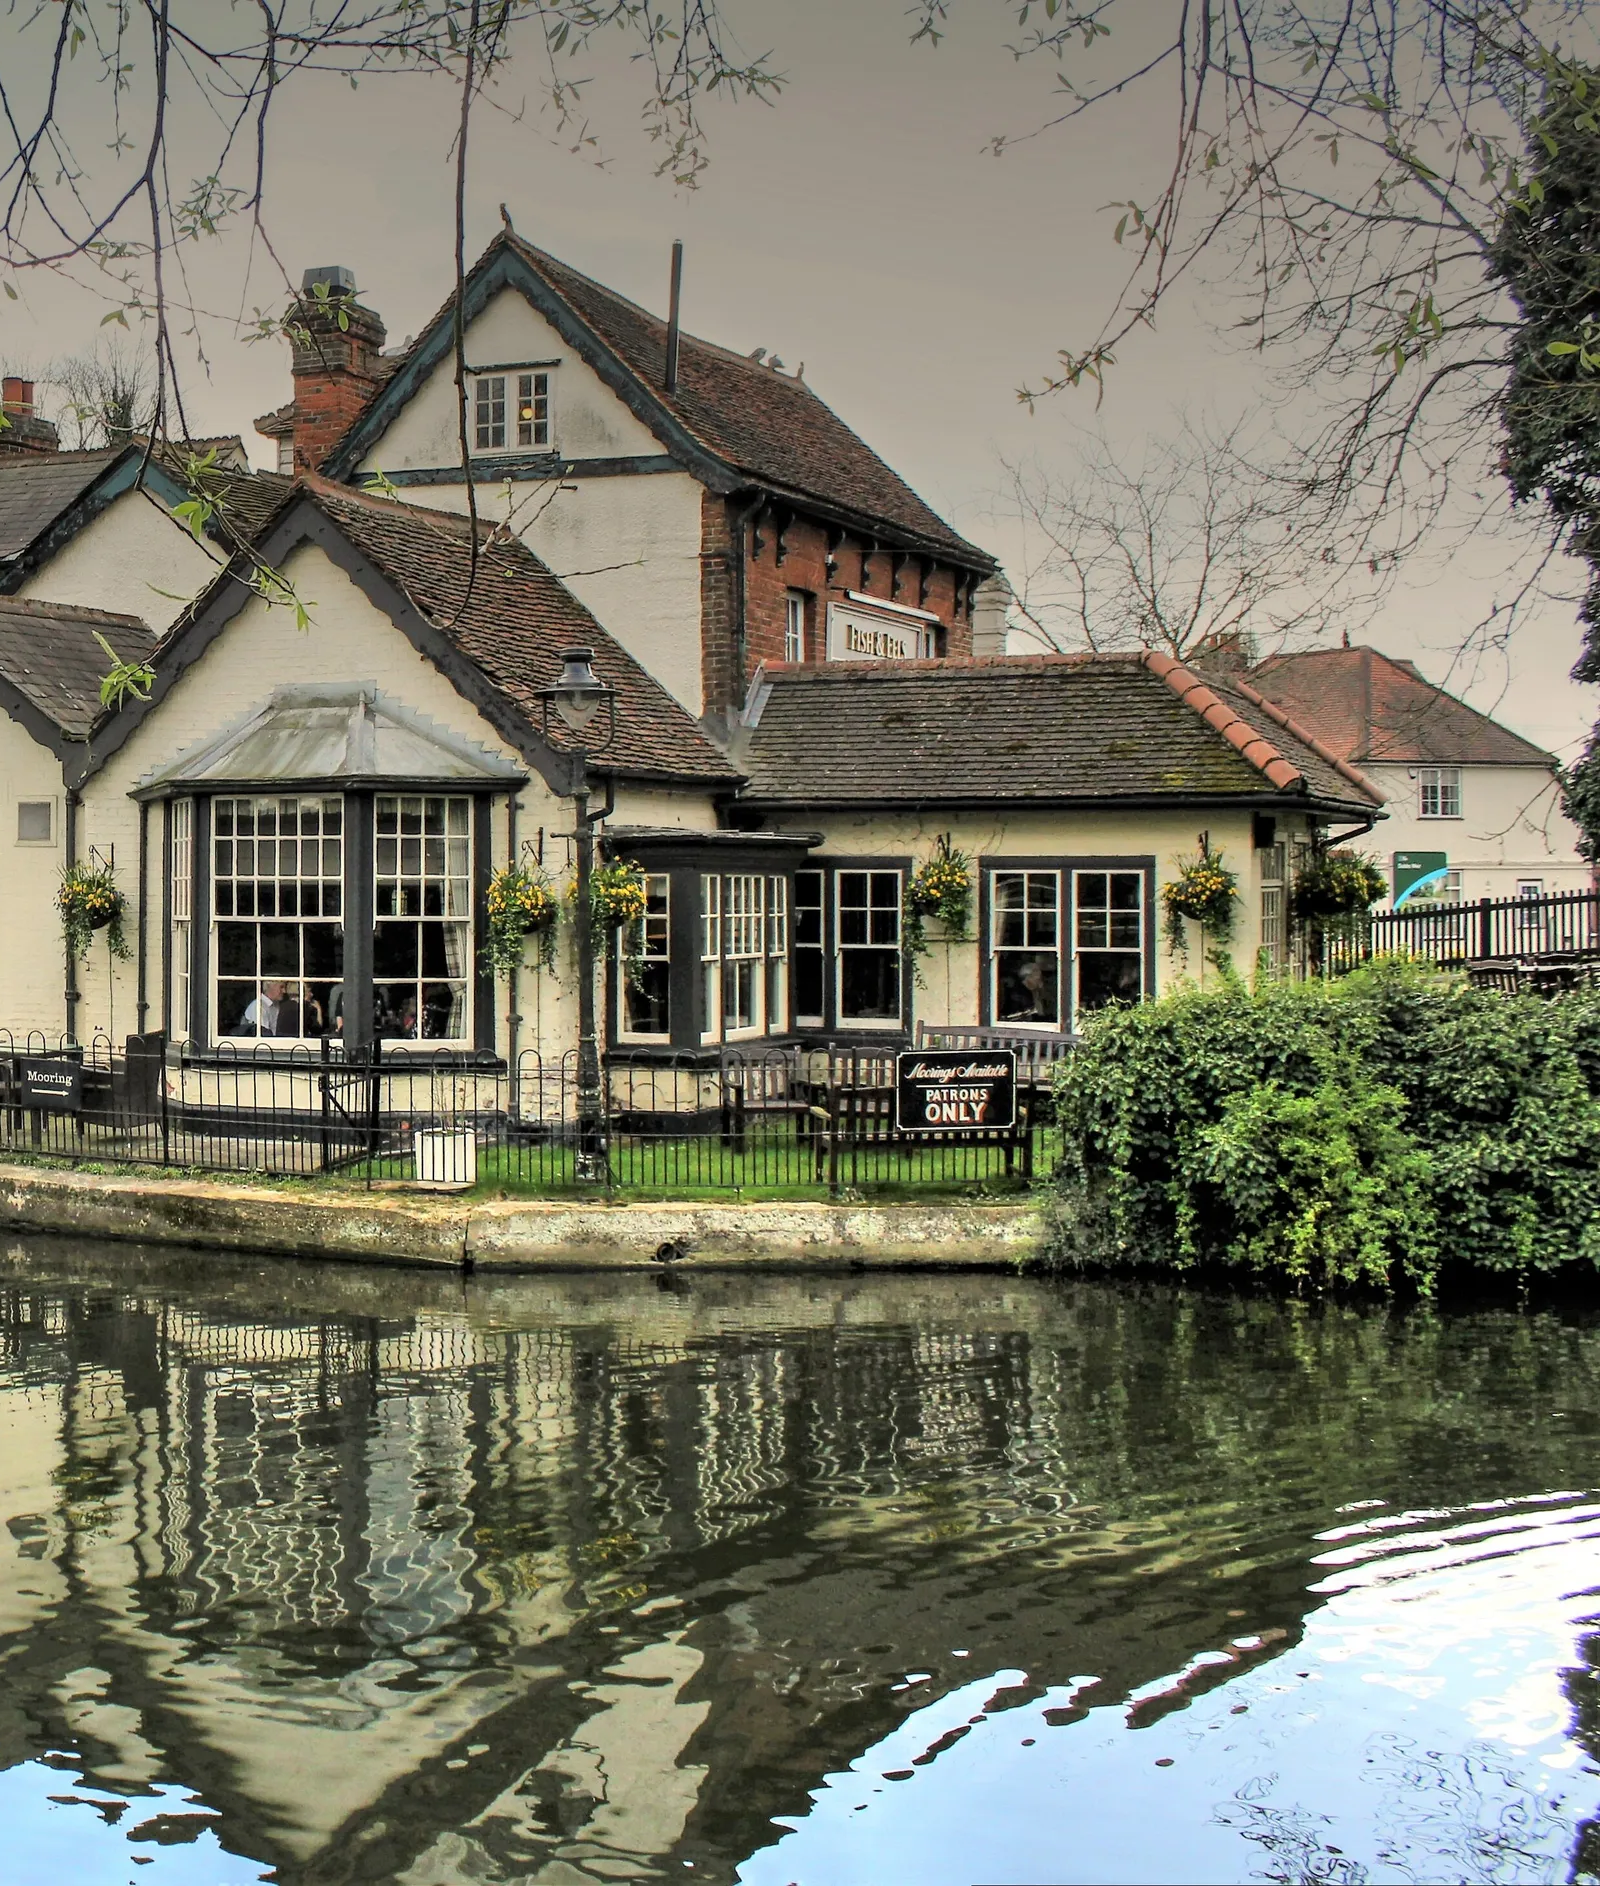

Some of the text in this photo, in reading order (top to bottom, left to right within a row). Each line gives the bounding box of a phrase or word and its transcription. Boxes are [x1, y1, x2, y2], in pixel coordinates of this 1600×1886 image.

[847, 624, 908, 659] FISH & EELS
[27, 1070, 73, 1087] Mooring
[904, 1062, 1009, 1083] Moorings Available
[926, 1088, 988, 1102] PATRONS
[925, 1102, 986, 1122] ONLY
